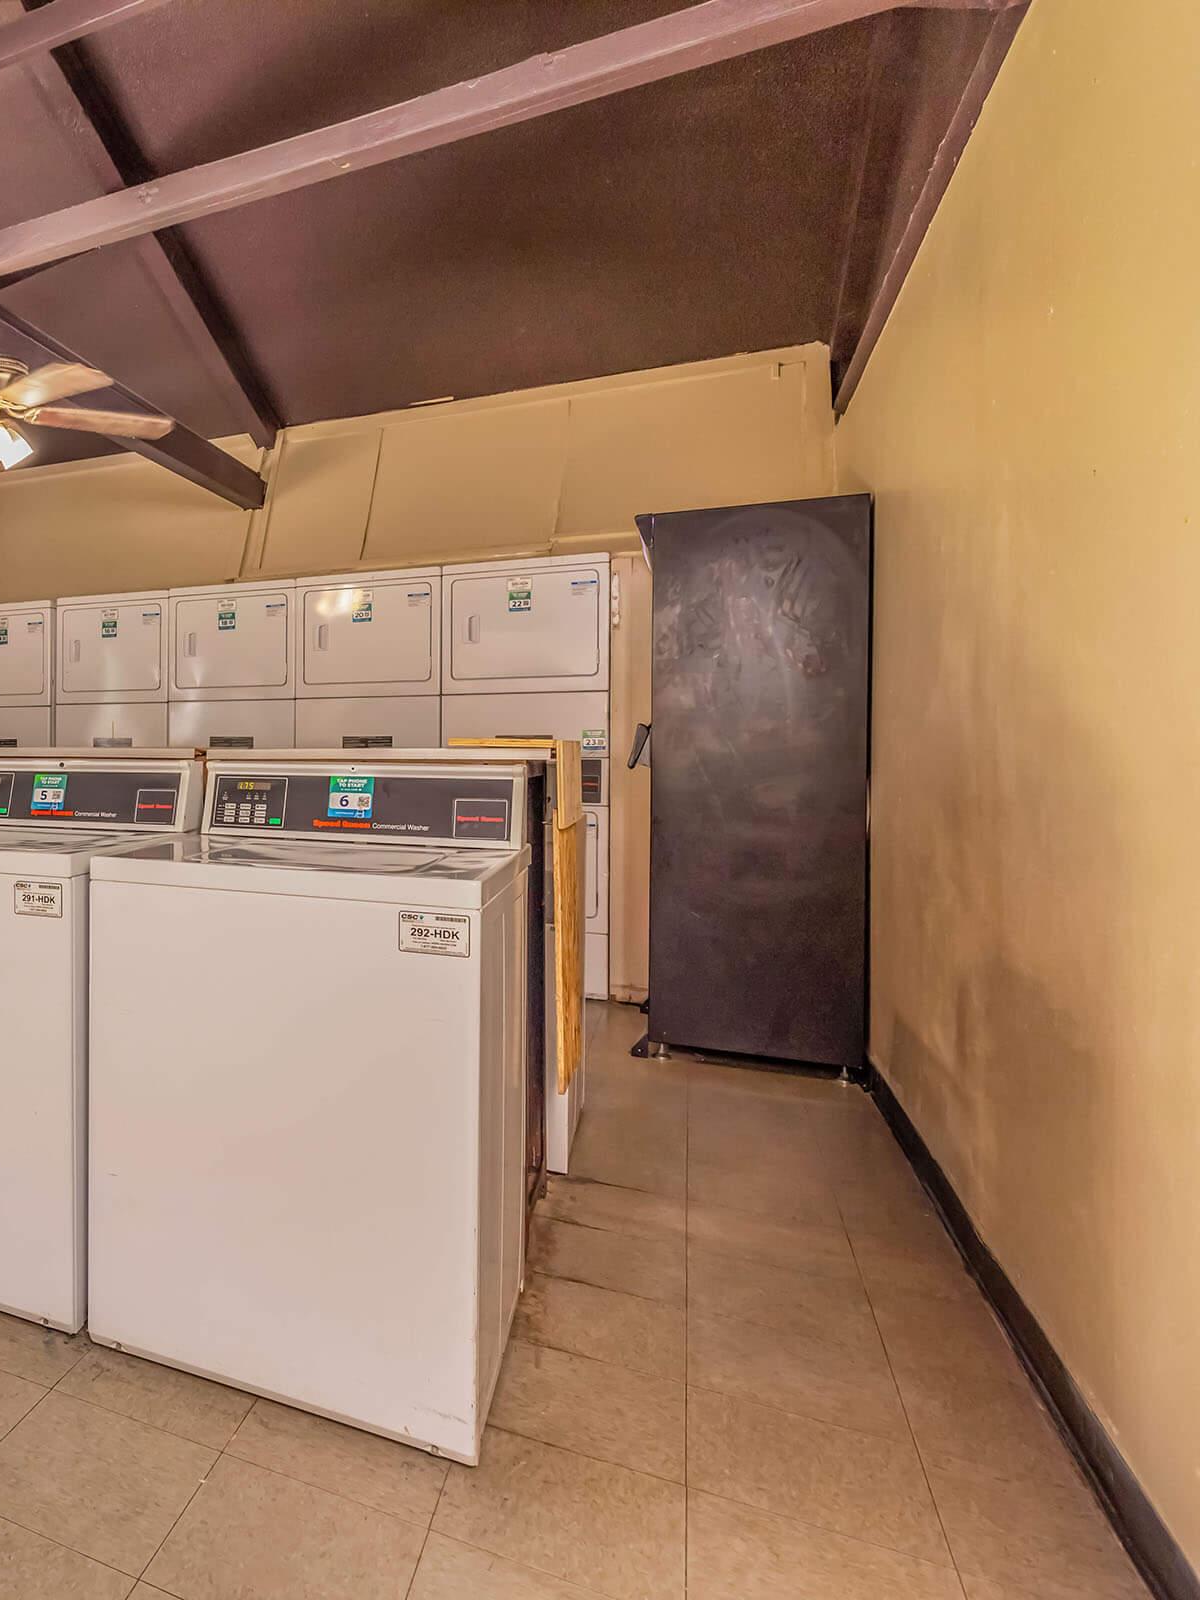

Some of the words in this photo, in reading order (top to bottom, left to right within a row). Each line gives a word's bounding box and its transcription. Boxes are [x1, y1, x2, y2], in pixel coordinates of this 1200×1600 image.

[39, 790, 48, 800] 5
[339, 794, 349, 807] 6
[74, 810, 100, 818] Commercial
[100, 811, 117, 819] Washer
[371, 822, 407, 831] Commercial
[407, 824, 430, 832] Washer
[22, 893, 56, 905] 291-HDK
[401, 913, 419, 921] CSC
[410, 927, 460, 941] 292-HDK
